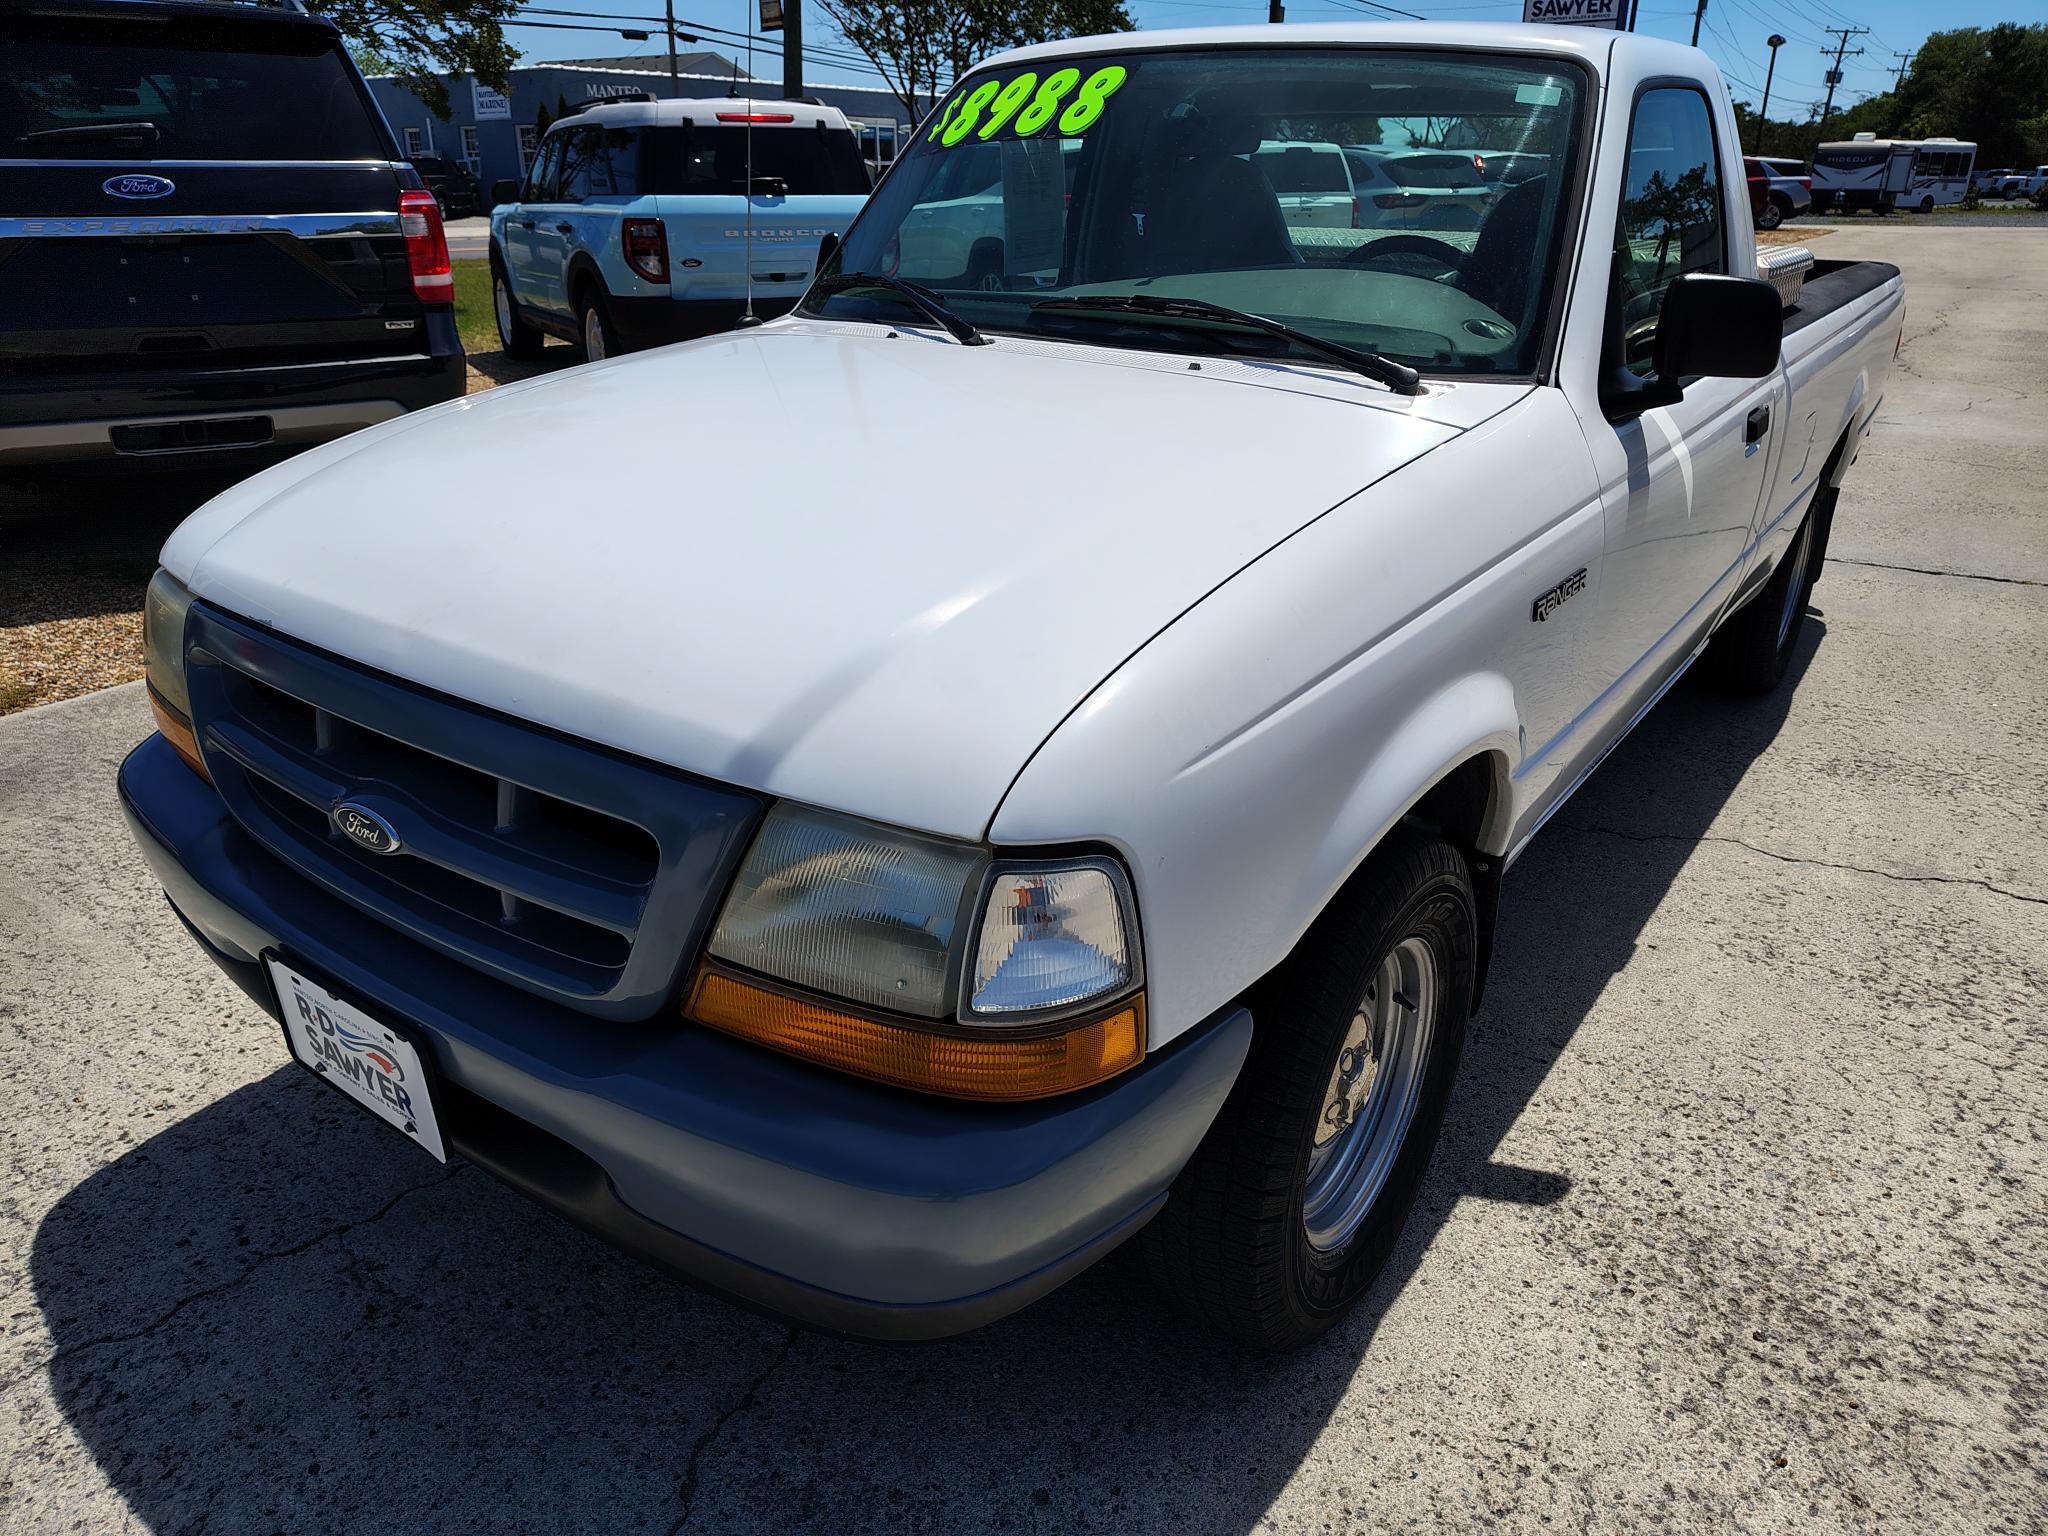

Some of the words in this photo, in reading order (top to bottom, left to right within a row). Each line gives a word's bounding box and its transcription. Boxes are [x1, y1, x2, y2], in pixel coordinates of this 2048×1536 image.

[1531, 0, 1612, 17] SAWYER
[585, 83, 642, 98] MANTEO
[927, 65, 1128, 148] $8988
[1827, 155, 1873, 164] HIDEOUT
[120, 178, 159, 193] Ford
[22, 220, 265, 233] EXPEDITION
[723, 229, 827, 238] BRONCO
[1532, 568, 1588, 622] RANGER
[346, 812, 380, 844] Ford
[305, 1024, 416, 1120] SAWYER
